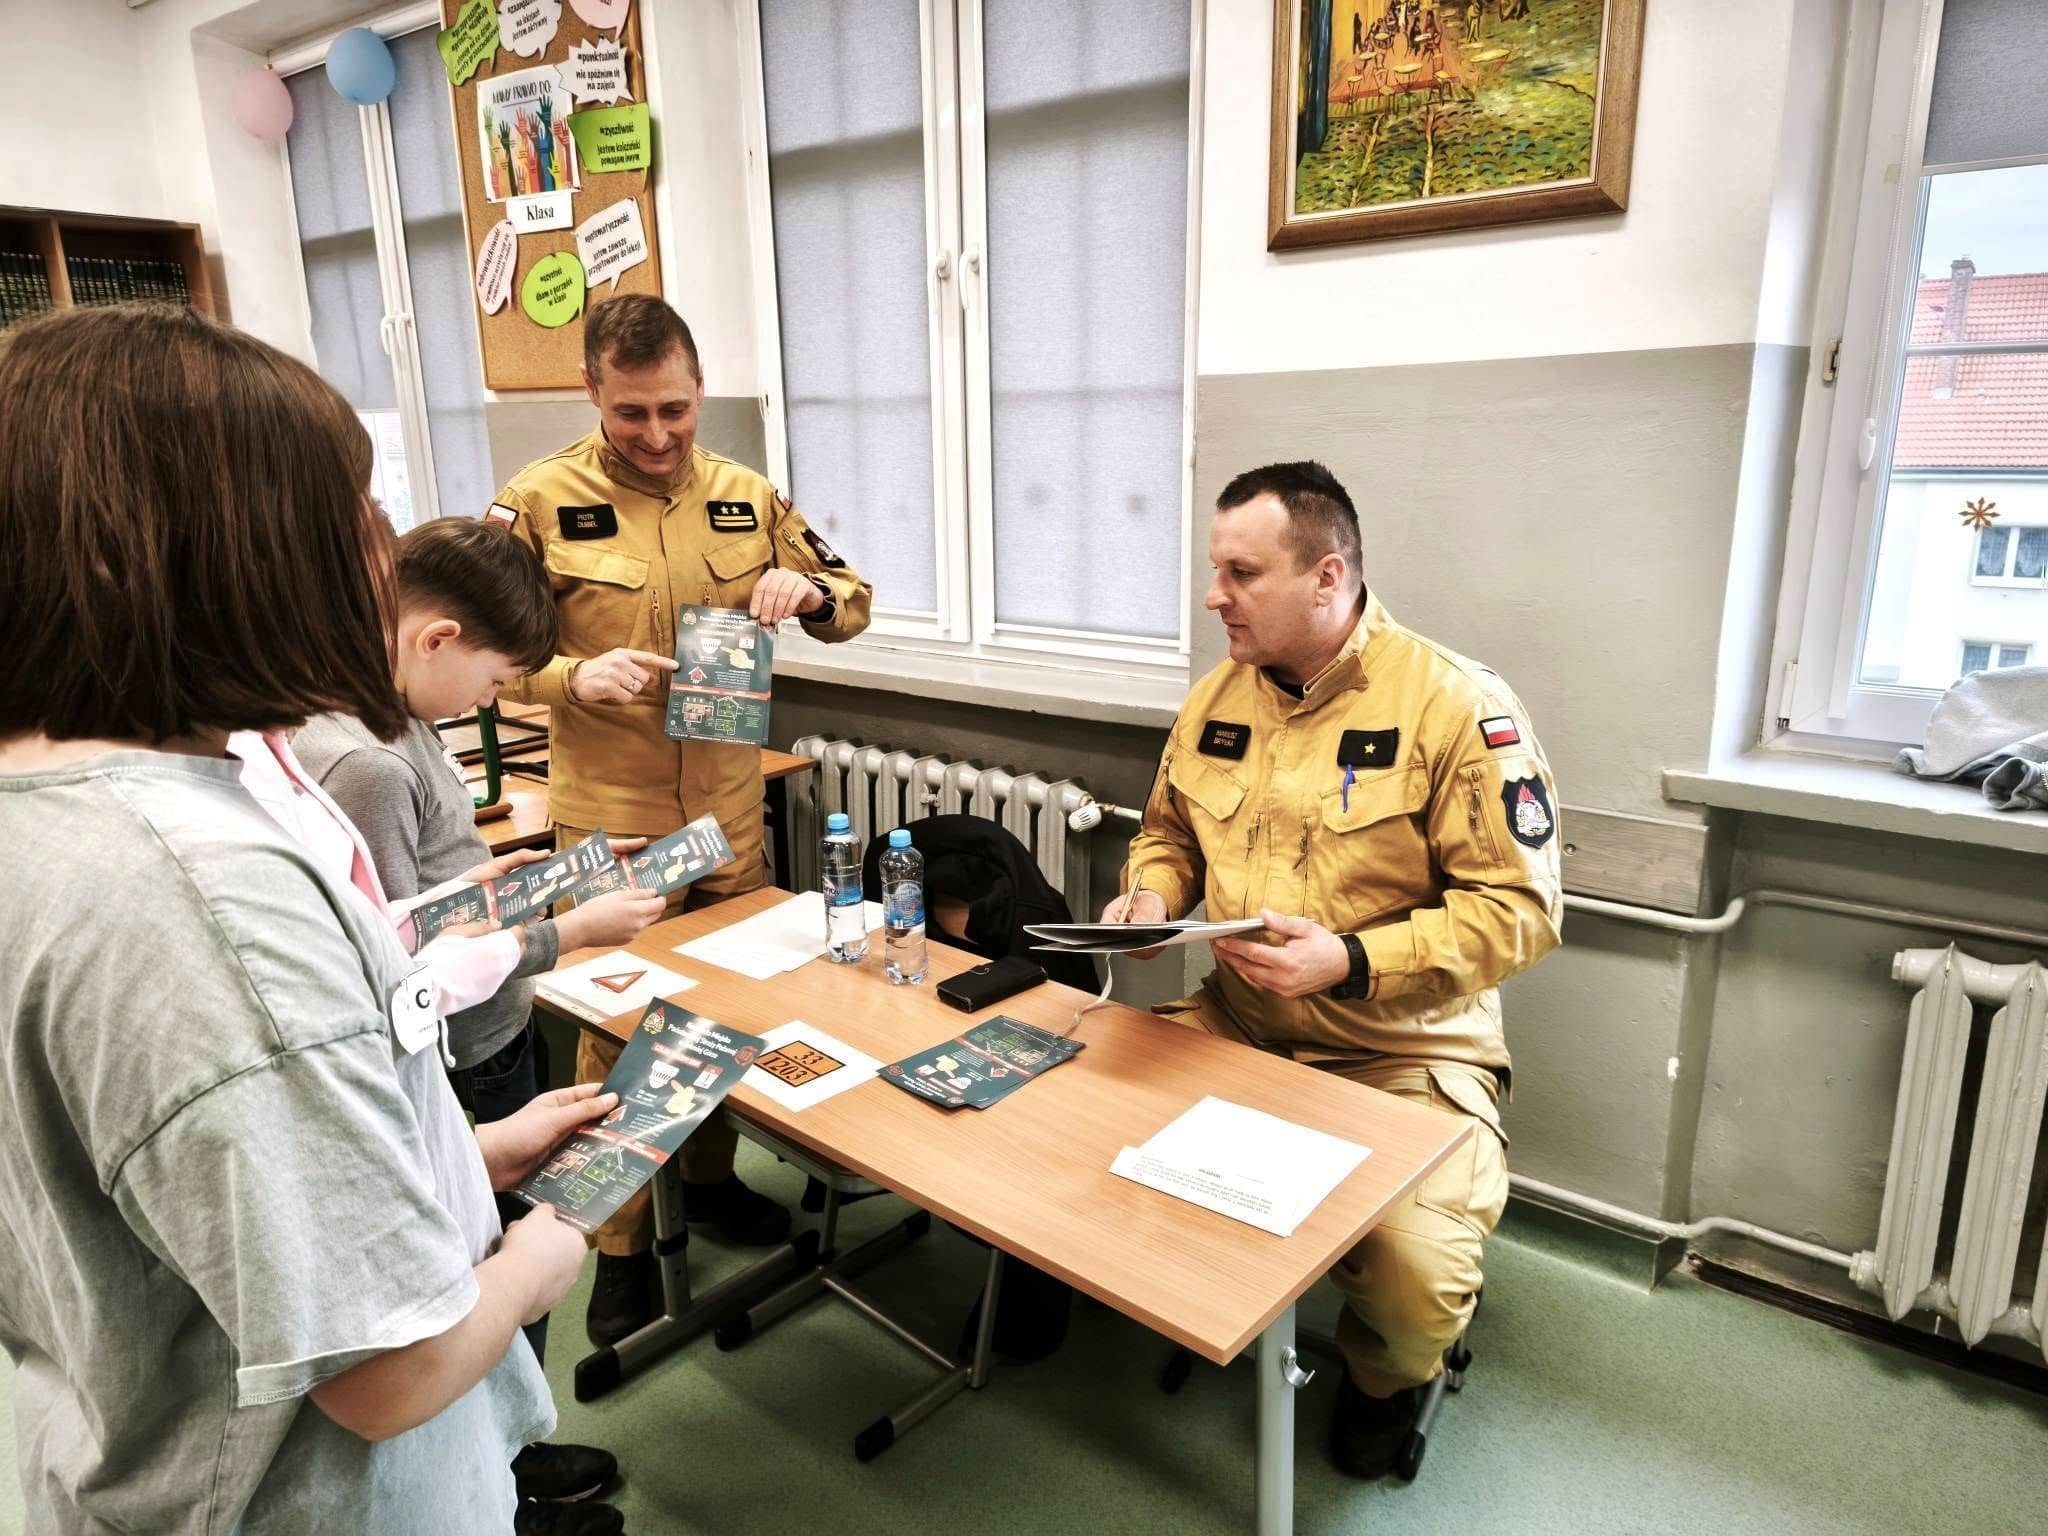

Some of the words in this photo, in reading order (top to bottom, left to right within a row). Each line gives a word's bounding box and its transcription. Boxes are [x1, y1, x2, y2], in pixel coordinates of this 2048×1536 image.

[526, 205, 555, 221] Klasa
[416, 988, 430, 1009] C
[794, 1051, 824, 1065] 33
[762, 1057, 808, 1080] 1203
